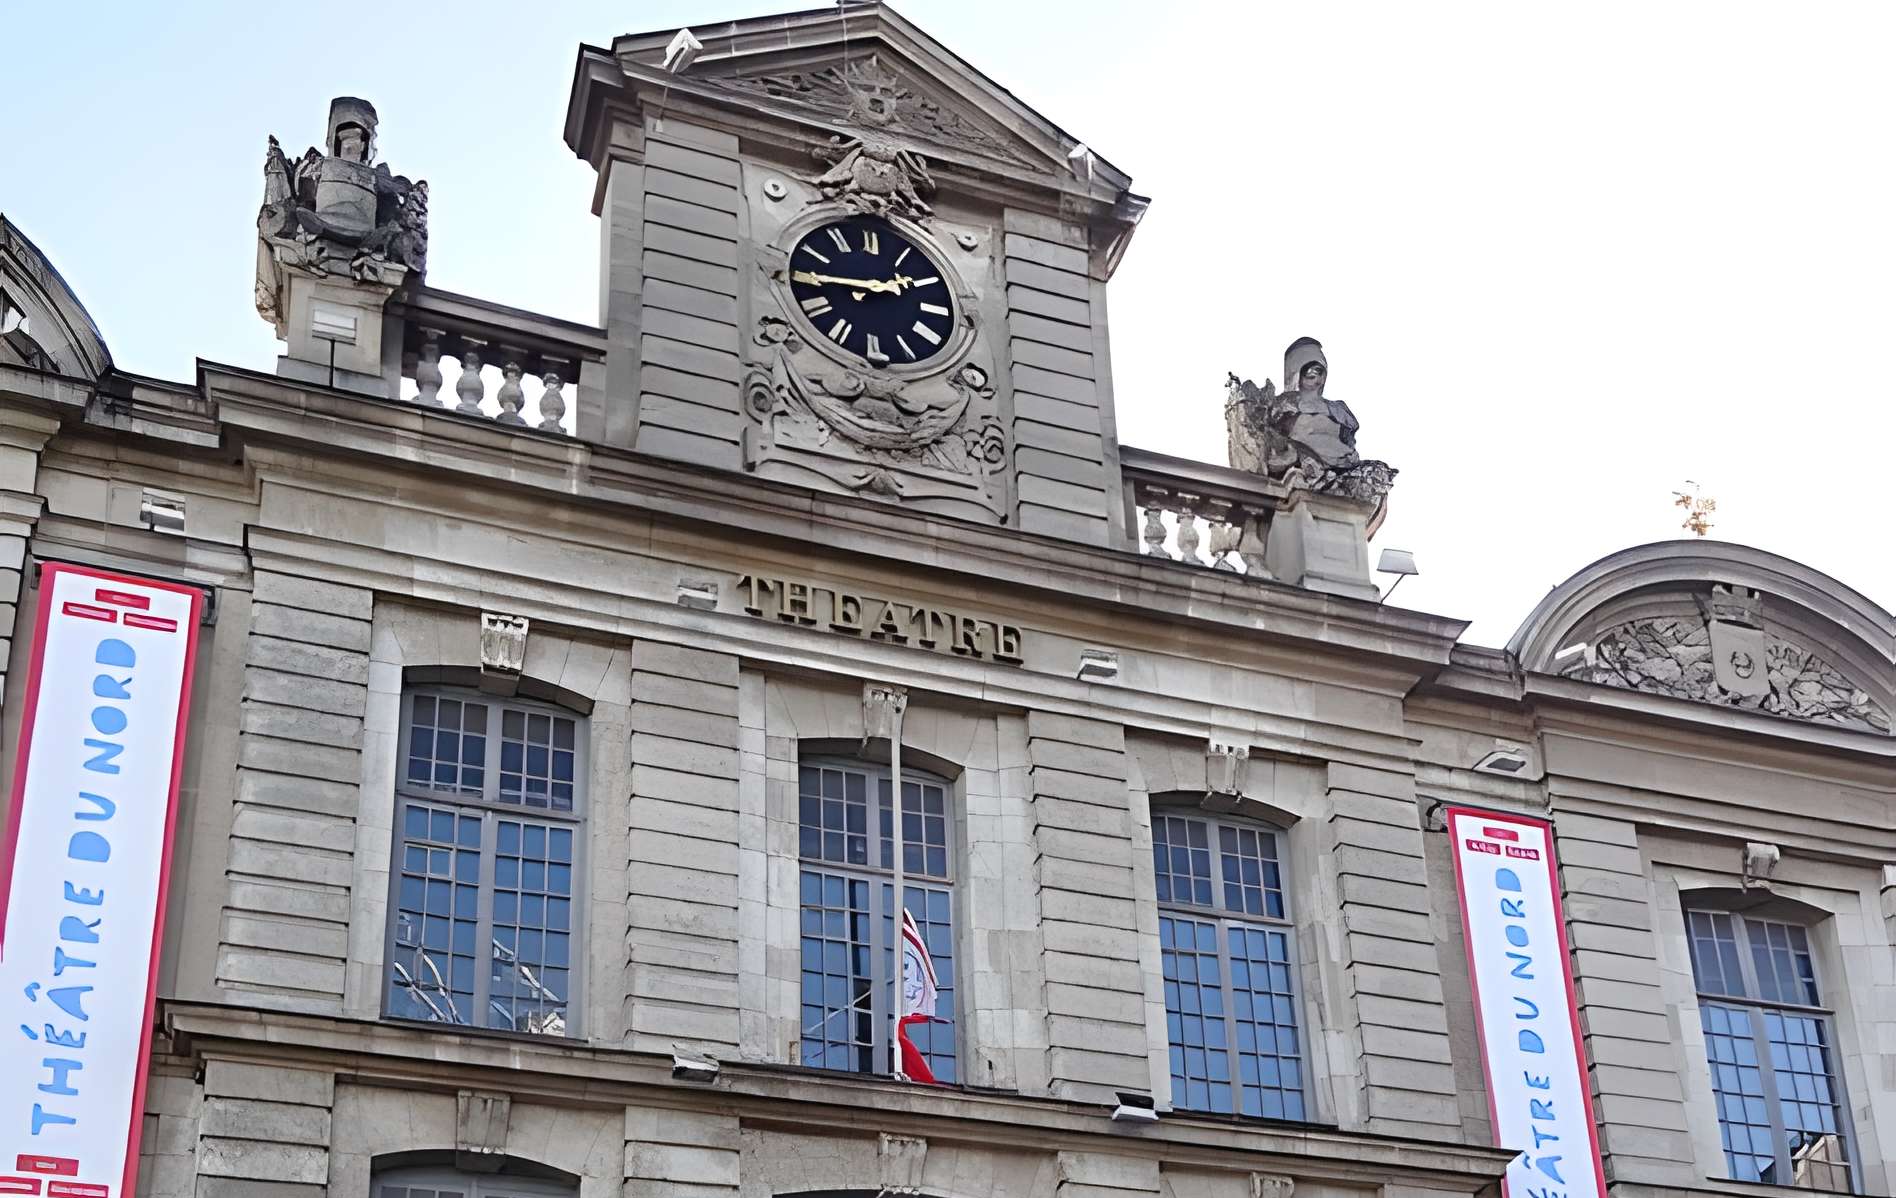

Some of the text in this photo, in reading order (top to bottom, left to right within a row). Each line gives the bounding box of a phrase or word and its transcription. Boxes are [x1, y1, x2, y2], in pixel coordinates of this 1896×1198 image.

[737, 573, 1024, 665] THEATRE
[82, 637, 137, 775] NORD
[67, 791, 117, 863] DU
[1494, 867, 1535, 980] NORD
[20, 880, 105, 1136] THÉÂTRE
[1513, 996, 1545, 1054] DU
